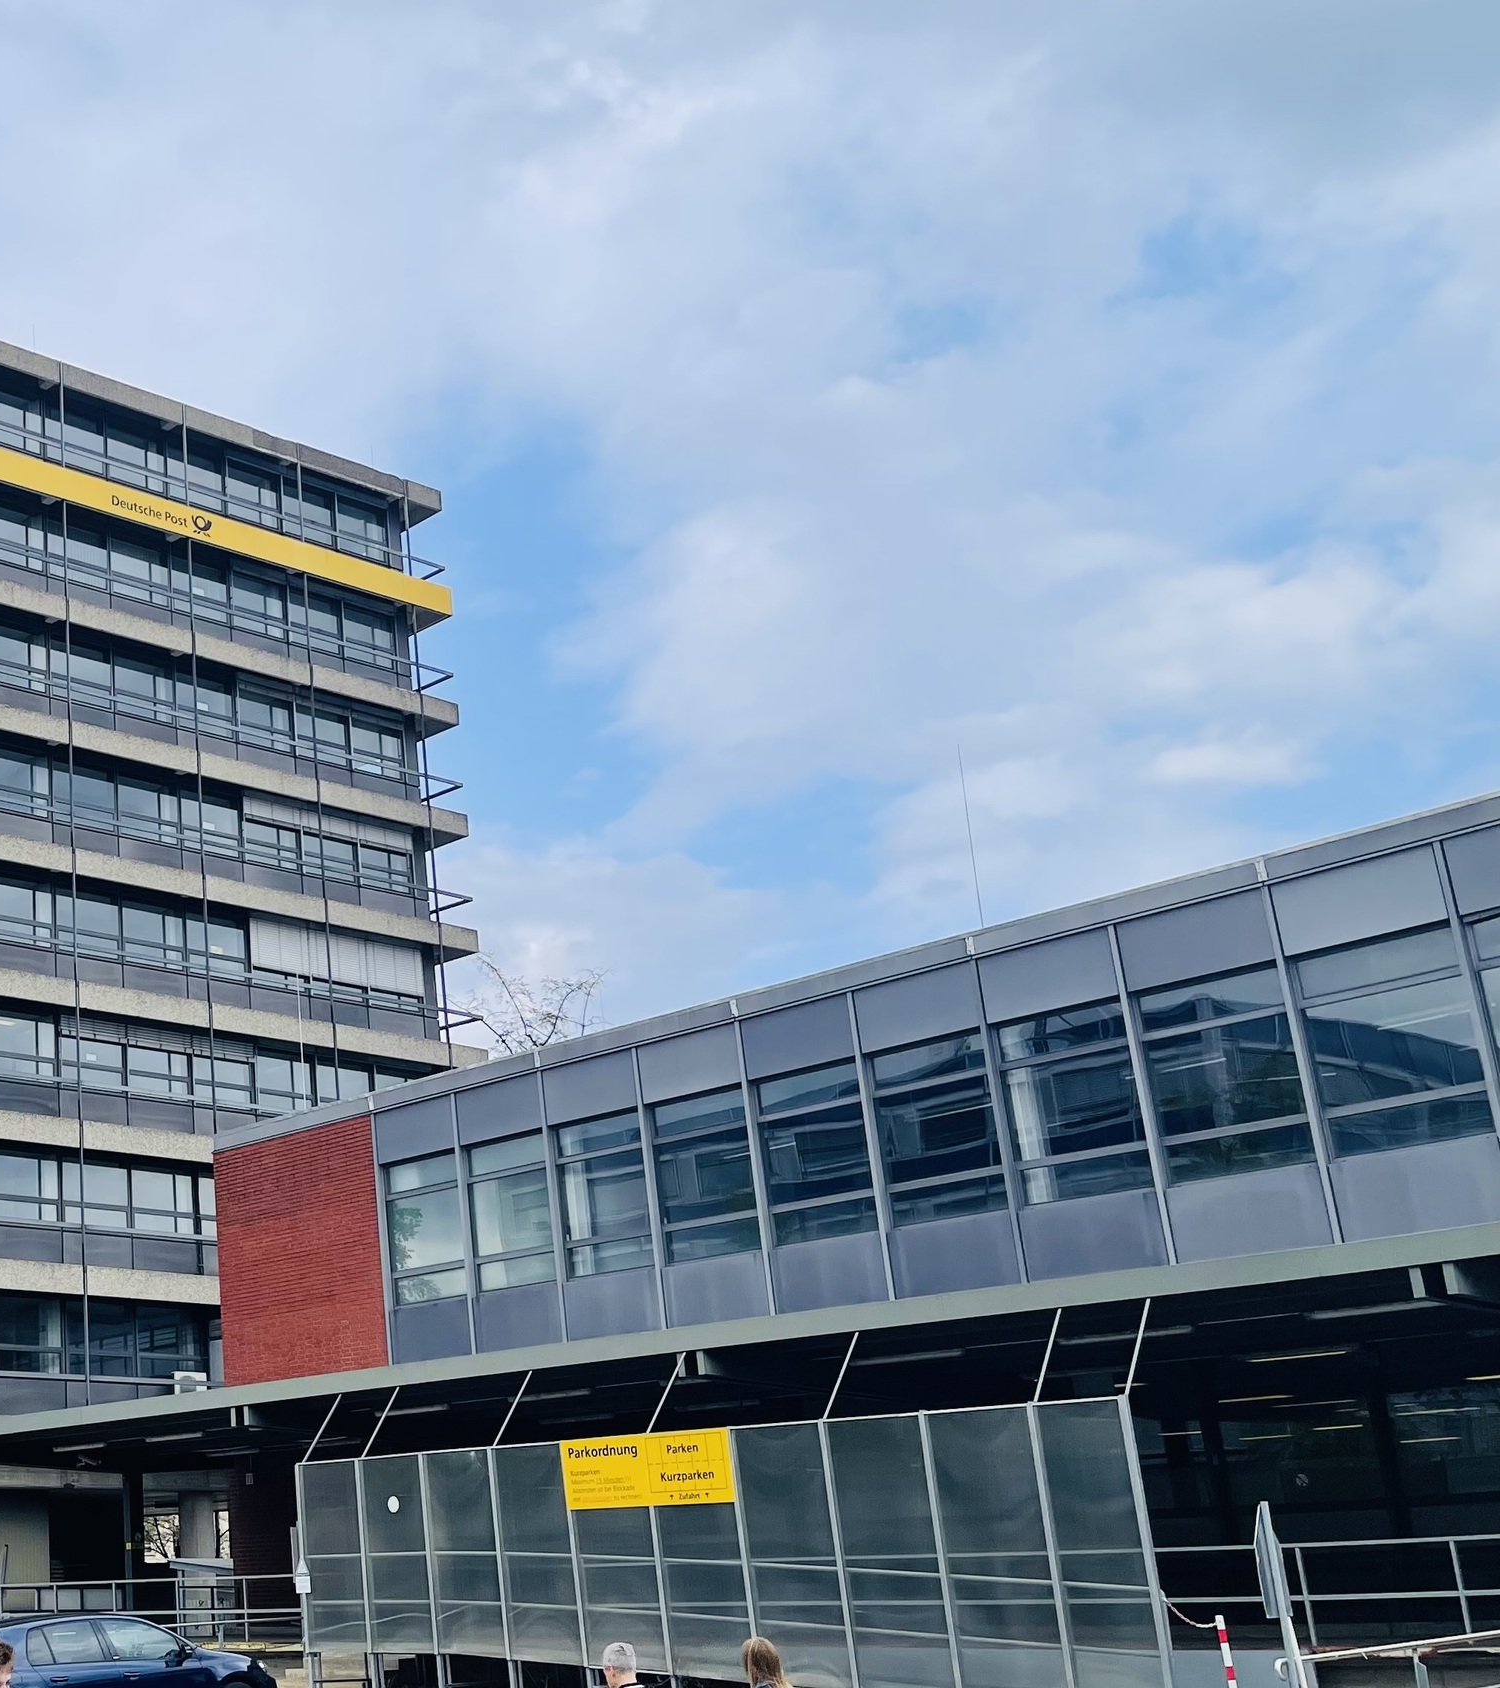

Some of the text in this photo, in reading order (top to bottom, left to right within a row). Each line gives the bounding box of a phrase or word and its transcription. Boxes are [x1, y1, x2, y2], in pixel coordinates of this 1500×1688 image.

[111, 495, 188, 528] Deutsche Post
[567, 1444, 638, 1459] Parkordnung
[666, 1443, 699, 1454] Parken
[660, 1469, 715, 1483] Kurzparken
[678, 1492, 701, 1500] Zufahrt
